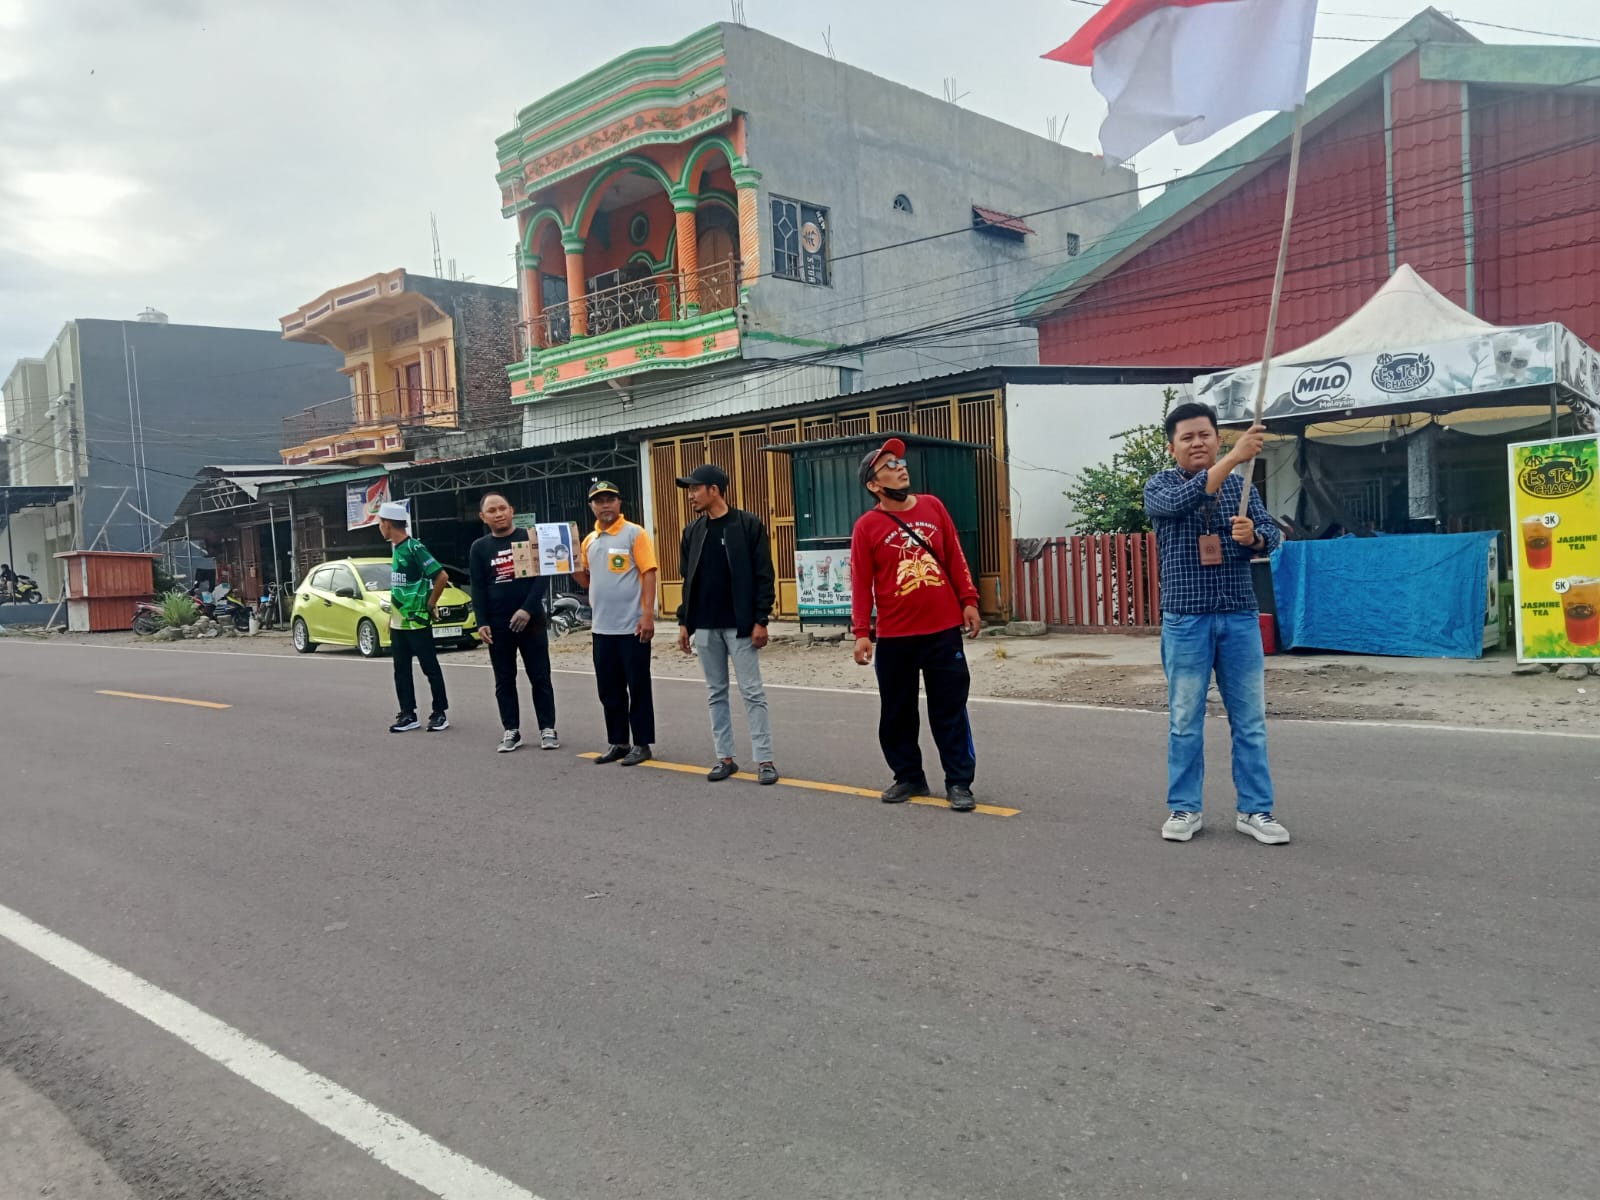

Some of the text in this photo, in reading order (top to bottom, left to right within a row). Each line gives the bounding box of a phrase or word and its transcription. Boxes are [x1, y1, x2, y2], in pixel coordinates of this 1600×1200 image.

[1377, 367, 1394, 383] Es
[1297, 374, 1346, 394] MILO
[1319, 398, 1356, 409] Malaysia
[1533, 481, 1578, 496] CHACA
[1544, 515, 1556, 525] 3K
[1557, 534, 1598, 544] JASMINE
[1555, 581, 1567, 590] 5K
[1521, 601, 1561, 609] JASMINE
